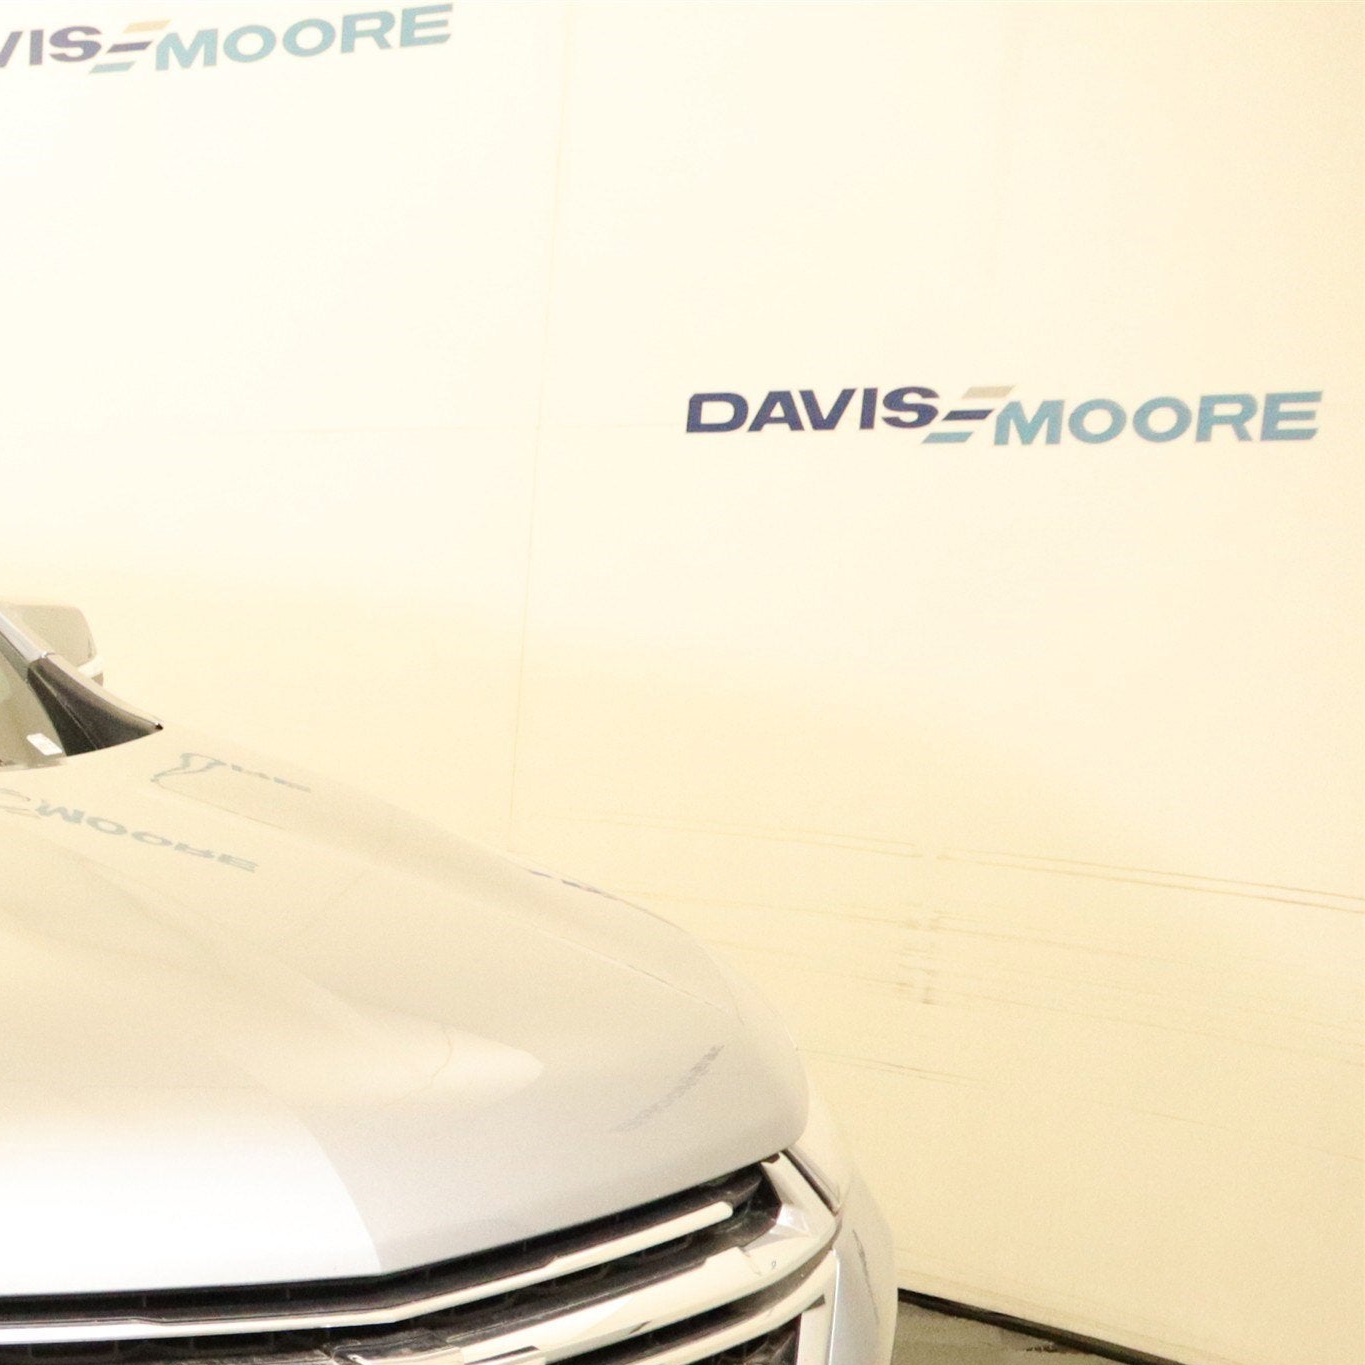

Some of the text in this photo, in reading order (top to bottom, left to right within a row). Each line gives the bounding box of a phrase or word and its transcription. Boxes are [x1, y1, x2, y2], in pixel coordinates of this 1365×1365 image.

[153, 4, 453, 72] MOORE
[685, 386, 1323, 446] DAVIS MOORE
